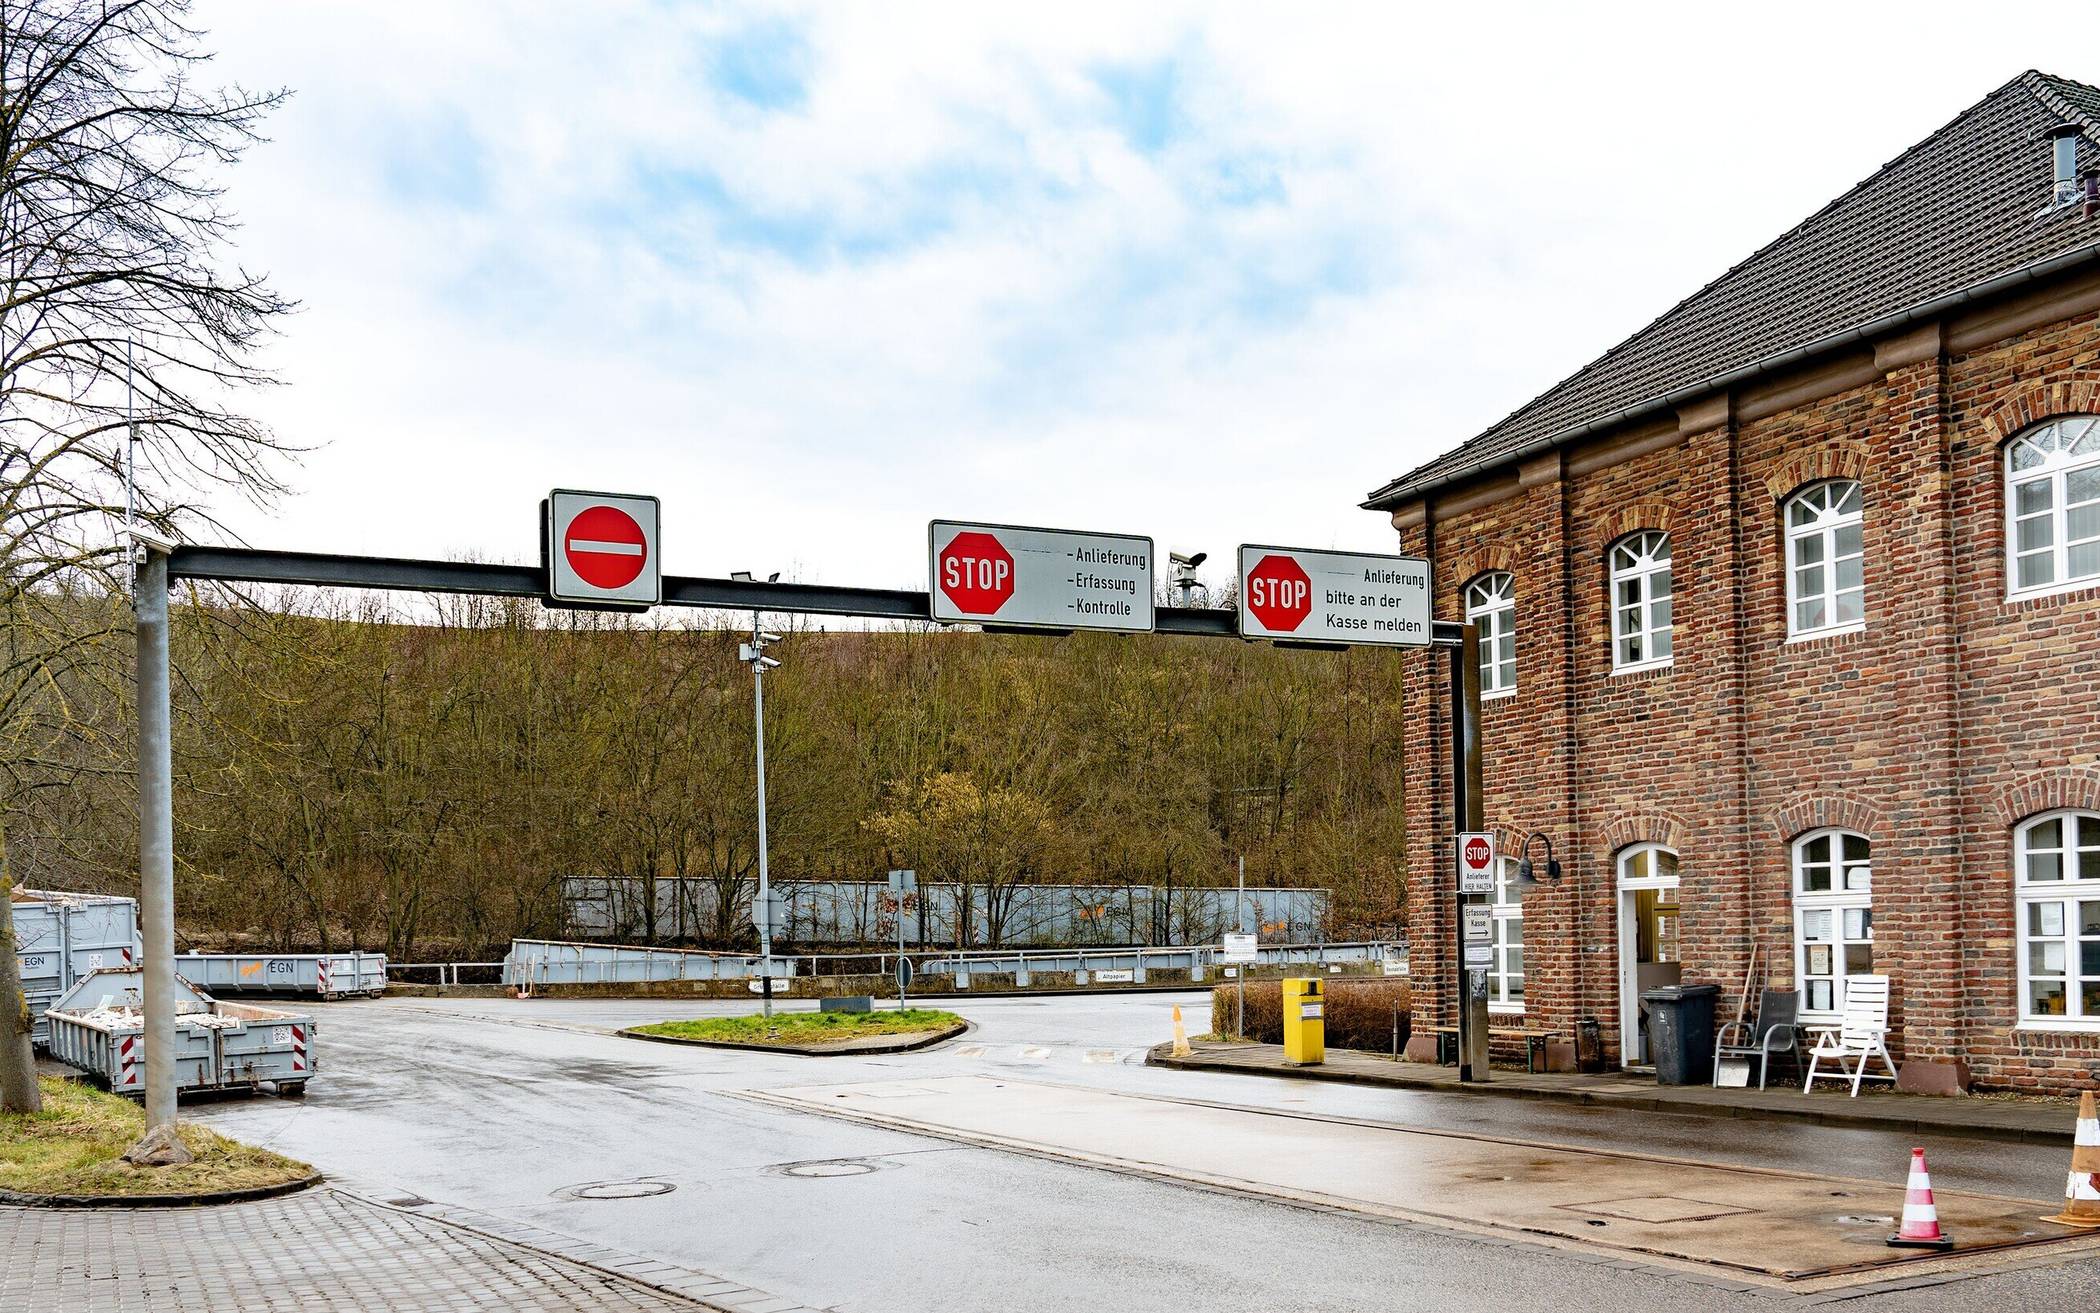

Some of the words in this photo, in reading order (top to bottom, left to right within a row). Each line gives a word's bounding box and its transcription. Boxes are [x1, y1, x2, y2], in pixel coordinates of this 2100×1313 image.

[945, 556, 1009, 591] STOP
[1364, 568, 1425, 590] Anlieferung
[1252, 577, 1307, 610] STOP
[1326, 589, 1355, 605] bitte
[1360, 594, 1376, 607] an
[1380, 593, 1402, 608] der
[1326, 613, 1368, 629] Kasse
[1374, 617, 1422, 633] melden
[1466, 846, 1489, 861] STOP
[1466, 872, 1490, 880] Anlieferer
[1465, 908, 1491, 918] Erfassung
[1470, 919, 1486, 927] Kasse
[24, 956, 45, 966] EGN
[270, 962, 294, 973] EGN
